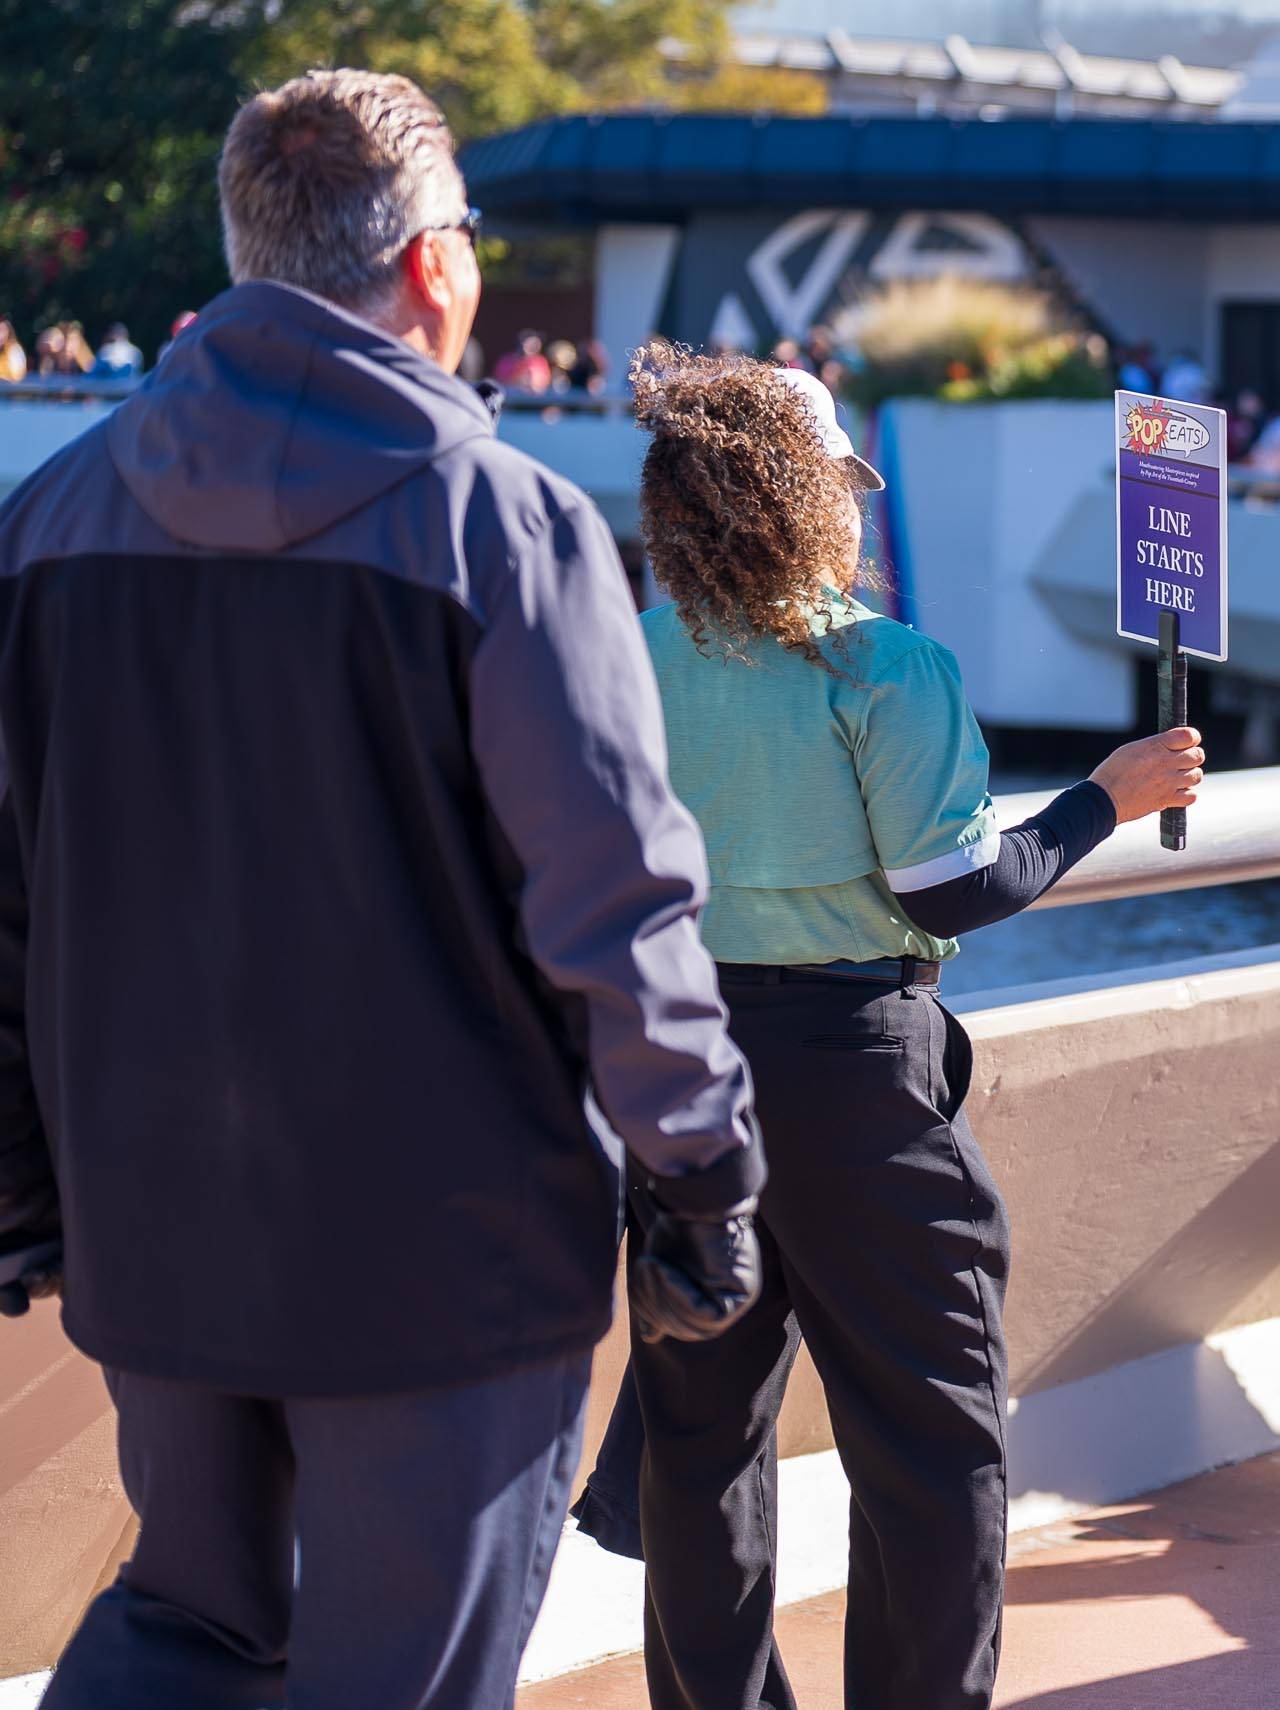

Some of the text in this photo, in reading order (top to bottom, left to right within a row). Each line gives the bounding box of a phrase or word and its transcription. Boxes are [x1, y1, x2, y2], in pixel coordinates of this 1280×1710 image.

[1132, 414, 1163, 446] POP
[1169, 424, 1204, 446] EATS!
[1148, 505, 1192, 538] LINE
[1136, 539, 1204, 578] STARTS
[1145, 577, 1196, 613] HERE
